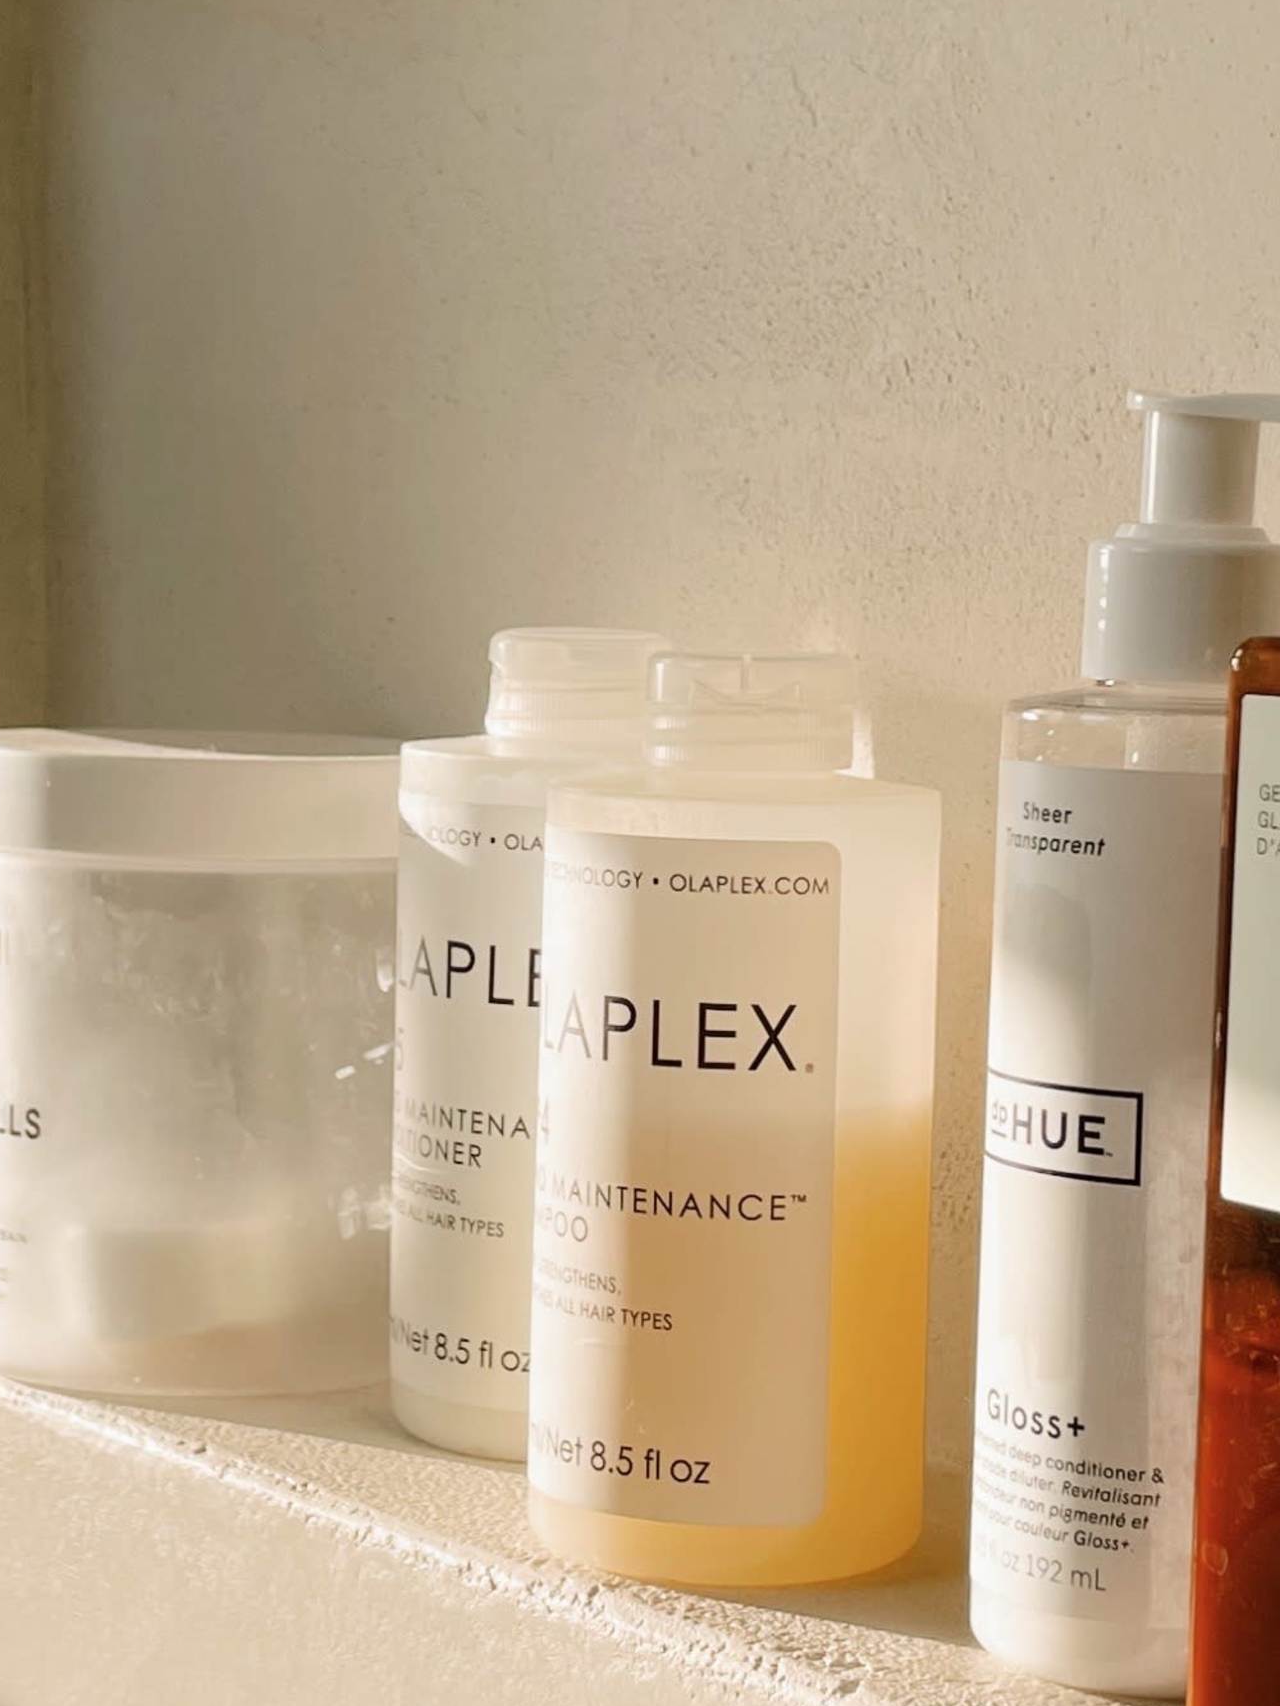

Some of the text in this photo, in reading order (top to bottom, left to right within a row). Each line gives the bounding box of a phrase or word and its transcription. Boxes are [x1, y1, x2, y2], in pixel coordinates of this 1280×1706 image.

[1023, 800, 1074, 825] Sheer
[1006, 827, 1107, 858] Transparent
[667, 872, 831, 896] OLAPLEX.COM
[459, 1215, 505, 1239] TYPES
[578, 1300, 617, 1324] HAIR
[619, 1308, 674, 1332] TYPES
[432, 1331, 471, 1366] 8.5
[478, 1338, 494, 1371] fl
[986, 1388, 1087, 1440] Gloss+
[589, 1440, 634, 1478] 8.5
[643, 1446, 661, 1481] fl
[669, 1458, 712, 1486] oz
[1008, 1445, 1042, 1468] deep
[1045, 1456, 1147, 1483] conditioner
[1150, 1467, 1165, 1484] &
[1061, 1479, 1161, 1508] Revitalisant
[1019, 1497, 1150, 1531] non pigmenté et
[1013, 1518, 1070, 1543] couleur
[1026, 1552, 1065, 1585] 192
[1069, 1565, 1108, 1593] mL
